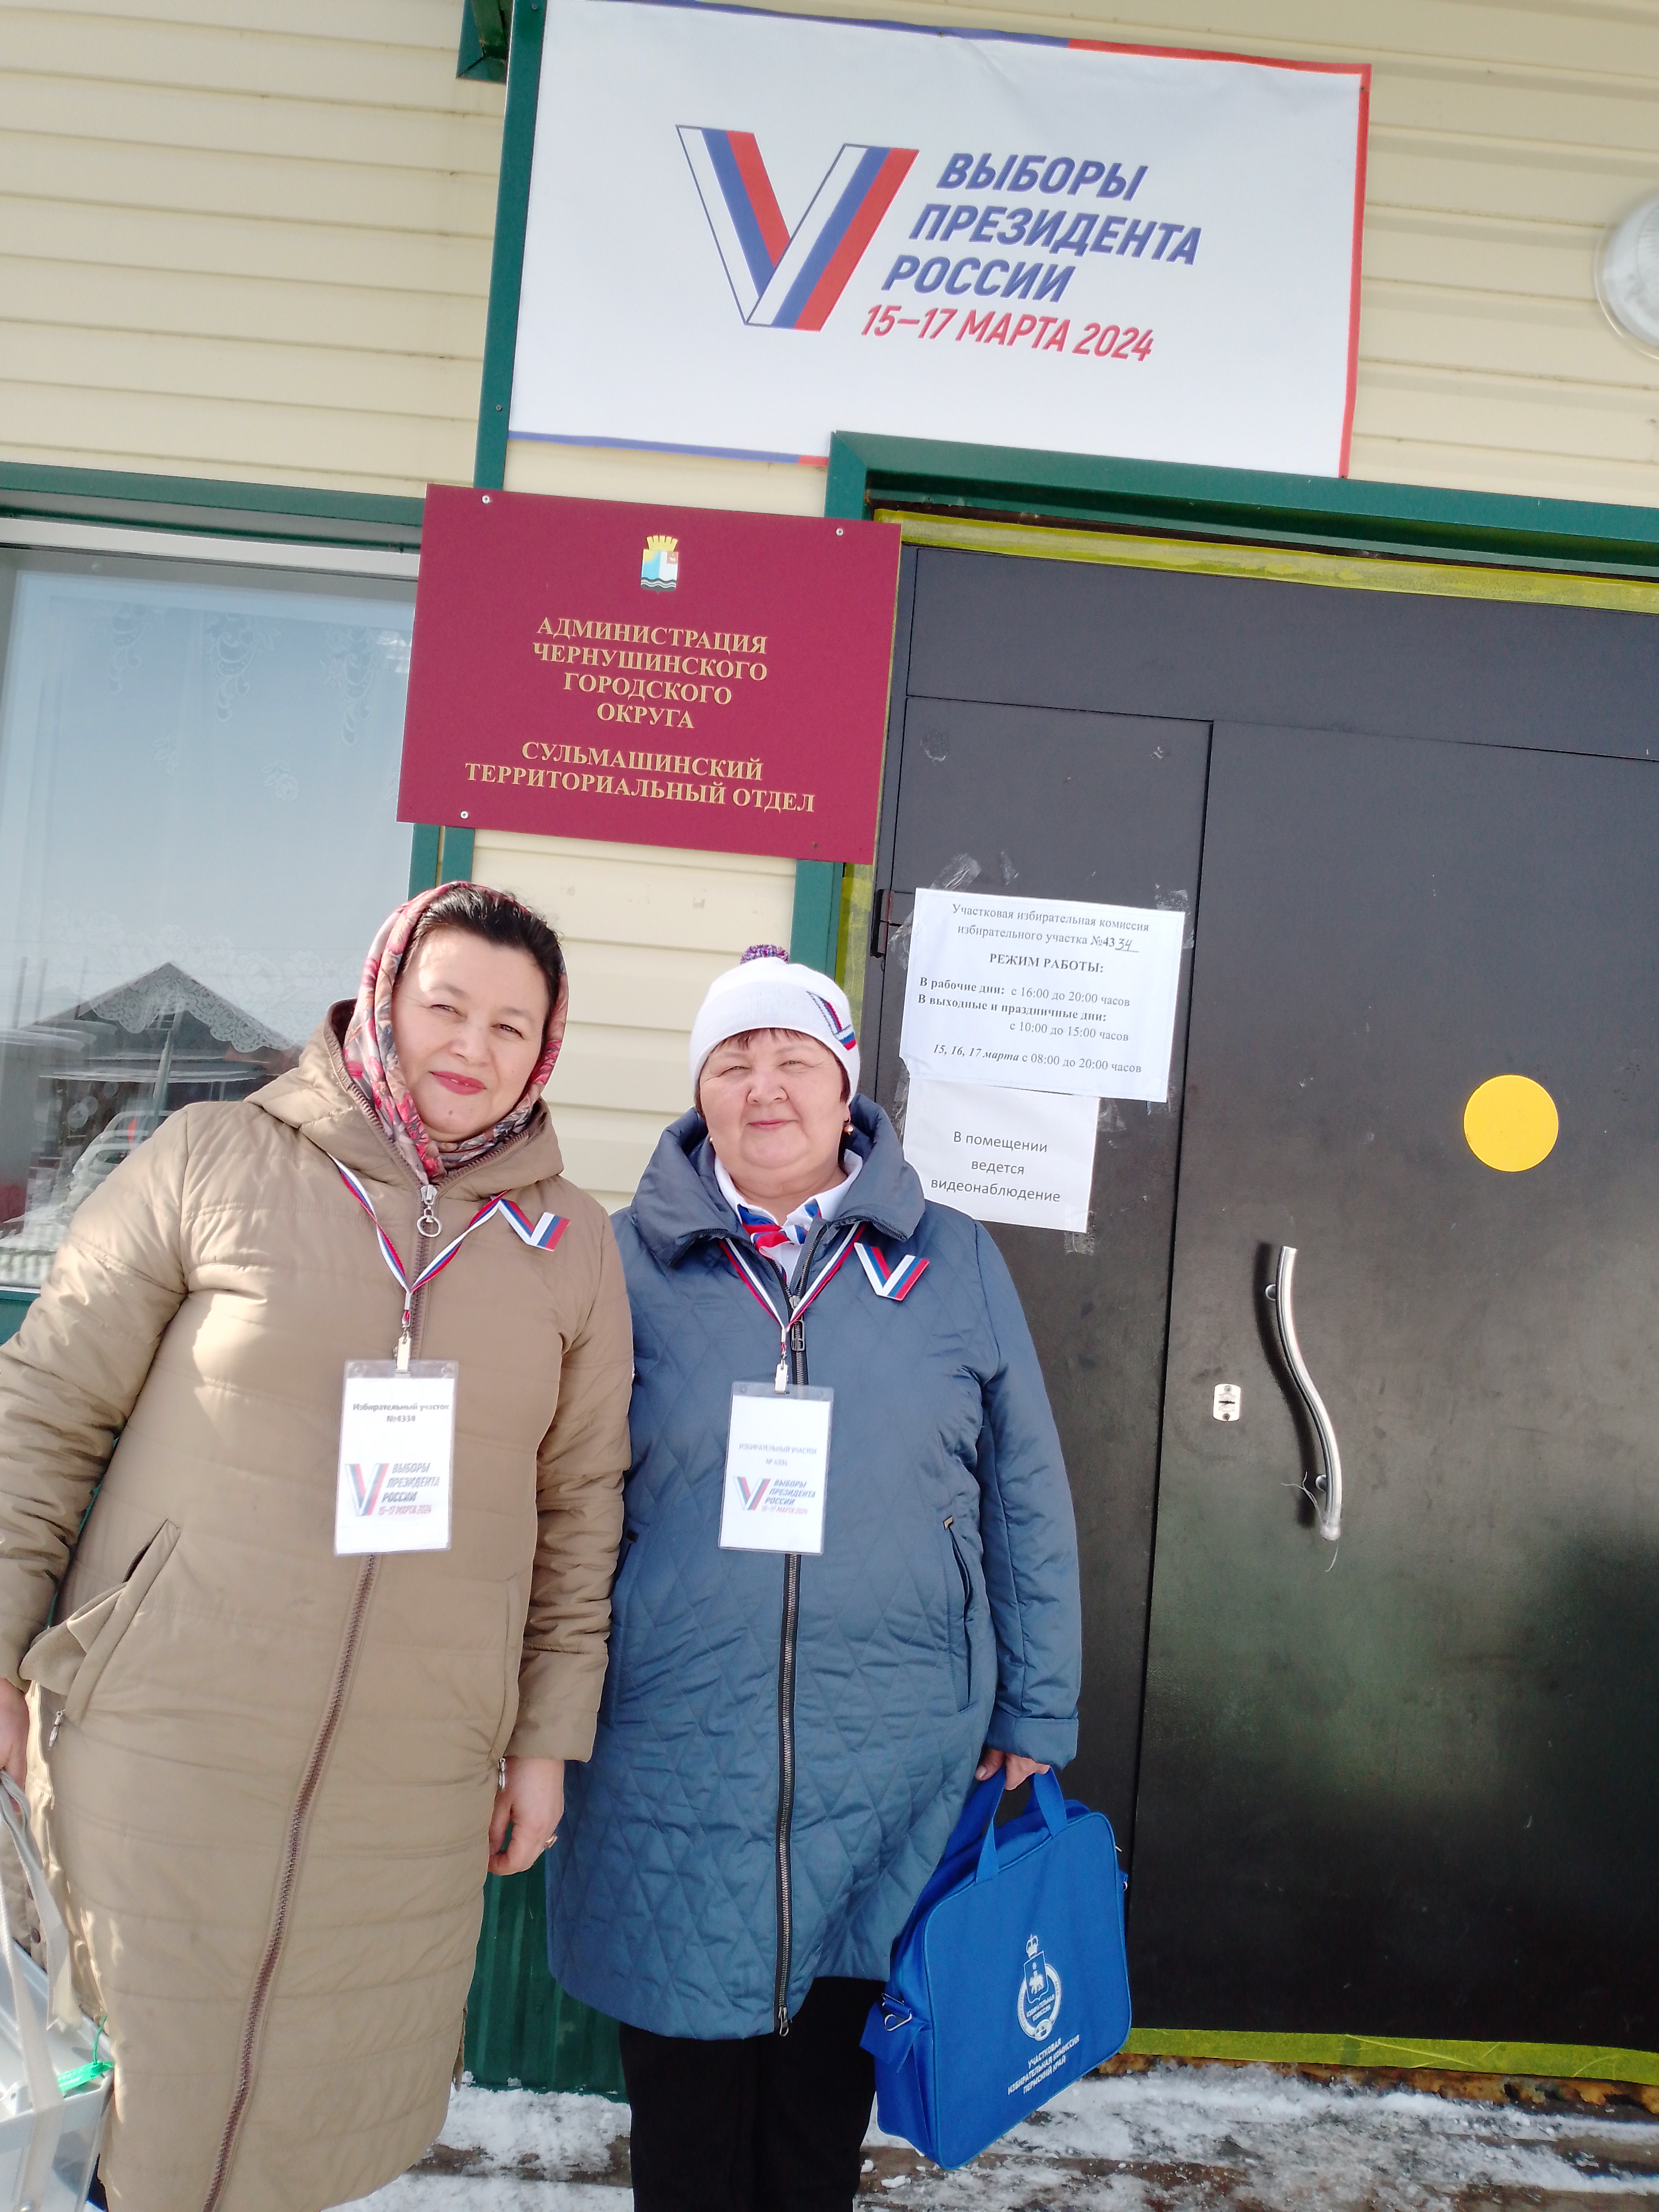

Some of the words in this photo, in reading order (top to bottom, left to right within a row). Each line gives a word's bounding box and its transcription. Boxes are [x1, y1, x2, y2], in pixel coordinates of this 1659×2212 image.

[936, 153, 1147, 202] ВЫБОРЫ
[908, 204, 1202, 266] ПРЕЗИДЕНТА
[881, 255, 1074, 303] РОССИИ
[956, 309, 1070, 353] МАРТА
[1073, 323, 1154, 363] 2024
[537, 617, 767, 655] АДМИНИСТРАЦИЯ
[533, 643, 767, 681] ЧЕРНУШИНСКОГО
[563, 673, 732, 706] ГОРОДСКОГО
[597, 703, 694, 730] ОКРУГА
[522, 742, 763, 781] СУЛЬМАШИНСКИЙ
[465, 763, 725, 806] ТЕРРИТОРИАЛЬНЫЙ
[733, 789, 814, 814] ОТДЕЛ
[953, 904, 1013, 919] Участковая
[1018, 911, 1095, 926] избирательная
[1099, 919, 1149, 931] комиссия
[958, 925, 1042, 940] избирательного
[1045, 934, 1087, 944] участка
[990, 953, 1039, 967] РЕЖИМ
[1043, 958, 1103, 973] РАБОТЫ:
[919, 977, 928, 986] В
[931, 979, 976, 992] рабочие
[979, 985, 1005, 995] дни:
[1020, 987, 1049, 999] 16:00
[1052, 993, 1065, 1001] до
[1068, 991, 1097, 1003] 20:00
[1101, 996, 1130, 1007] часов
[918, 994, 926, 1003] В
[929, 997, 987, 1010] выходные
[1001, 1004, 1078, 1019] праздничные
[1080, 1012, 1107, 1021] дни:
[1019, 1021, 1048, 1033] 10:00
[1050, 1027, 1063, 1036] до
[1067, 1026, 1096, 1038] 15:00
[1099, 1031, 1129, 1042] часов
[933, 1044, 948, 1055] 15,
[951, 1046, 965, 1057] 16,
[969, 1048, 982, 1058] 17
[982, 1050, 1019, 1062] марта
[1030, 1053, 1060, 1066] 08:00
[1062, 1059, 1075, 1068] до
[1078, 1058, 1108, 1070] 20:00
[1111, 1063, 1141, 1074] часов
[953, 1131, 961, 1143] В
[966, 1135, 1048, 1153] помещении
[971, 1161, 1025, 1175] ведется
[931, 1179, 1060, 1202] видеонаблюдение
[353, 1403, 418, 1412] Избирательный
[739, 1443, 790, 1453] ИЗБИРАТЕЛЬНЫЙ
[392, 1462, 431, 1473] ВЫБОРЫ
[387, 1477, 440, 1489] ПРЕЗИДЕНТА
[769, 1488, 816, 1498] ПРЕЗИДЕНТА
[774, 1479, 807, 1488] ВЫБОРЫ
[382, 1492, 417, 1503] РОССИИ
[1008, 2056, 1053, 2096] ИЗБИРАТЕЛЬНАЯ
[1053, 2034, 1080, 2061] КОМИССИЯ
[1028, 2037, 1061, 2069] УЧАСТКОВАЯ
[1024, 2066, 1052, 2094] ПЕРМСКИЙ
